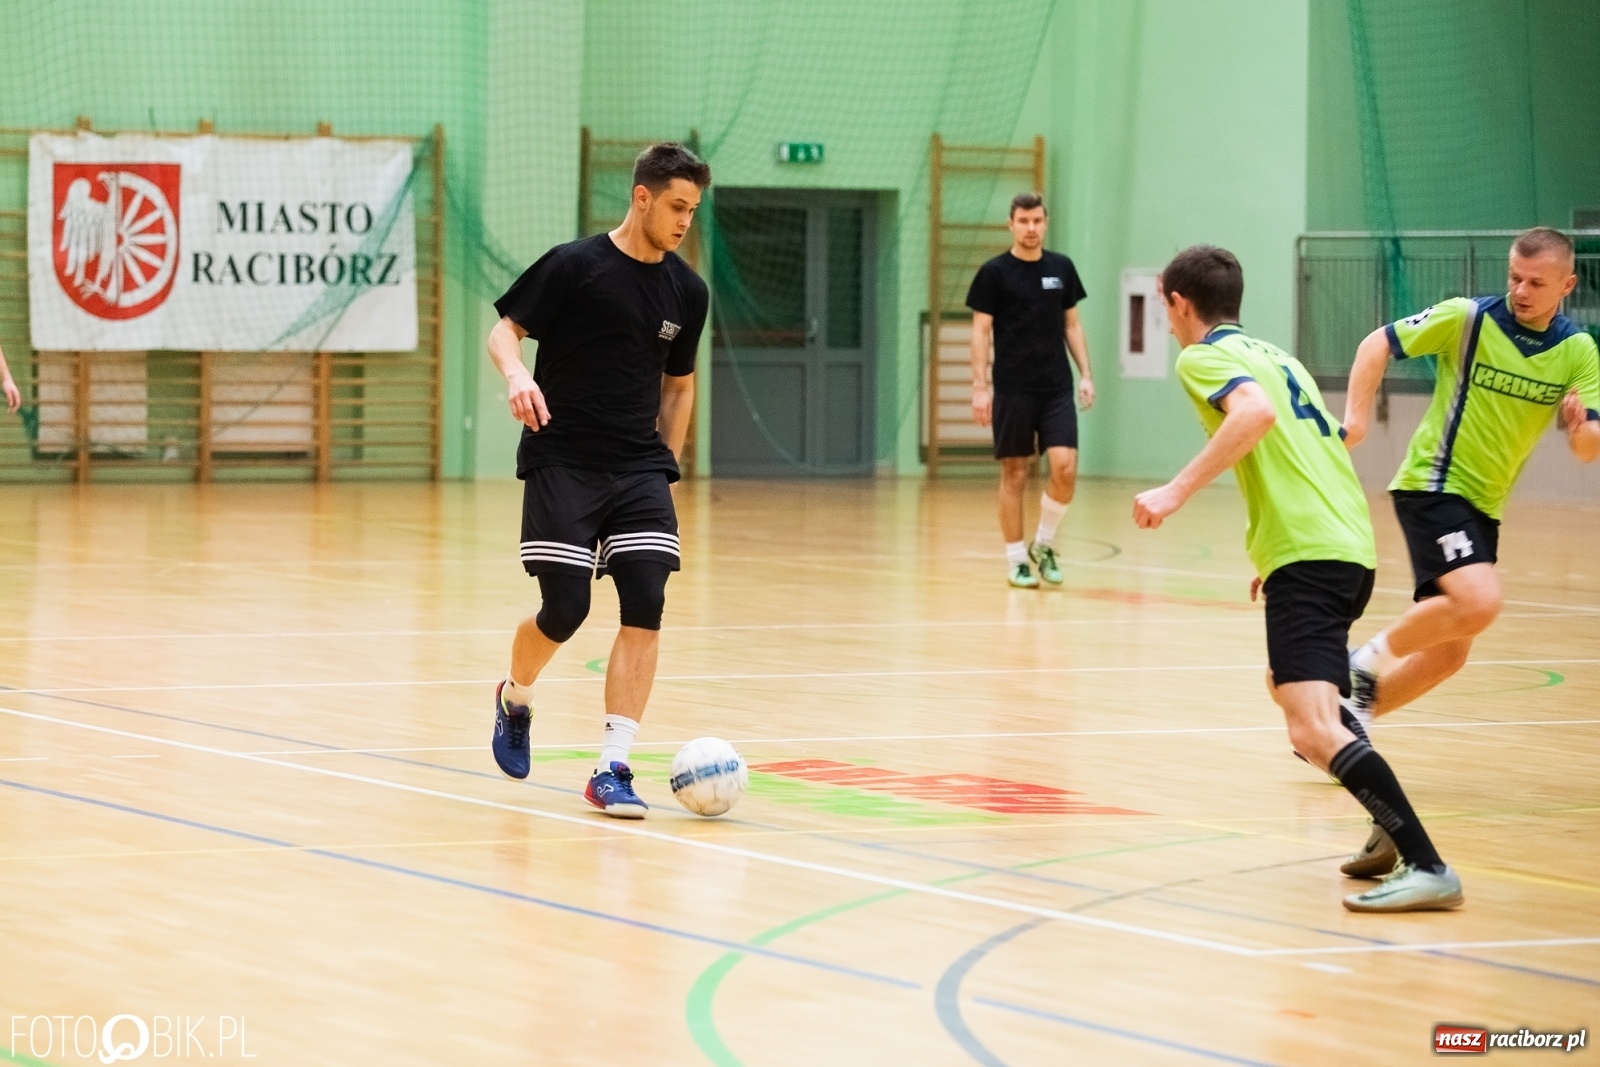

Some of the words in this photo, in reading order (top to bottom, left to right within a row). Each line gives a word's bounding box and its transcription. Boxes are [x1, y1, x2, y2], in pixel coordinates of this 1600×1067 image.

[216, 200, 374, 235] MIASTO
[190, 245, 401, 286] RACIBÓRZ
[1280, 364, 1331, 437] 4
